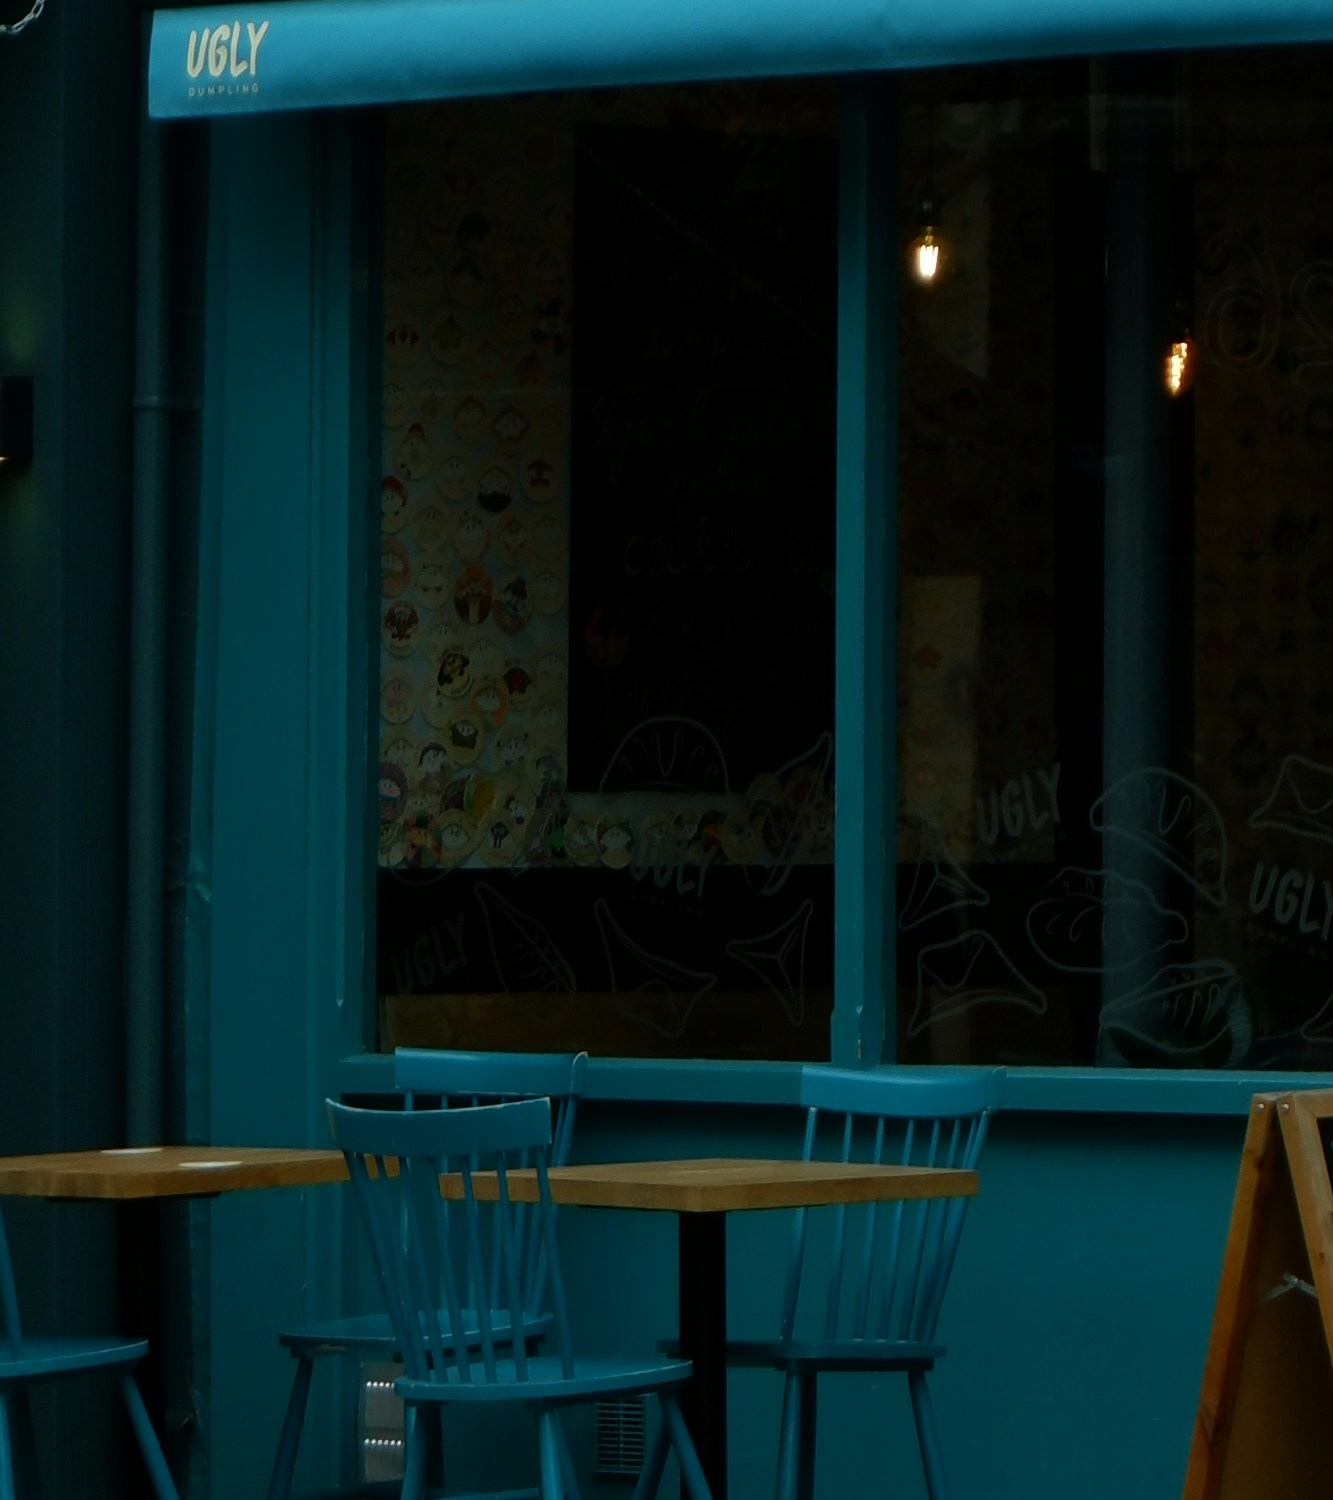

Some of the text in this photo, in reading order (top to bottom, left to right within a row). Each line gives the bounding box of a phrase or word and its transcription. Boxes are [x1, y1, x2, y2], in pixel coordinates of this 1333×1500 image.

[186, 20, 270, 78] UGLY
[188, 83, 260, 97] DUMPLING
[975, 761, 1062, 845] UGLY
[389, 907, 468, 996] UGLY
